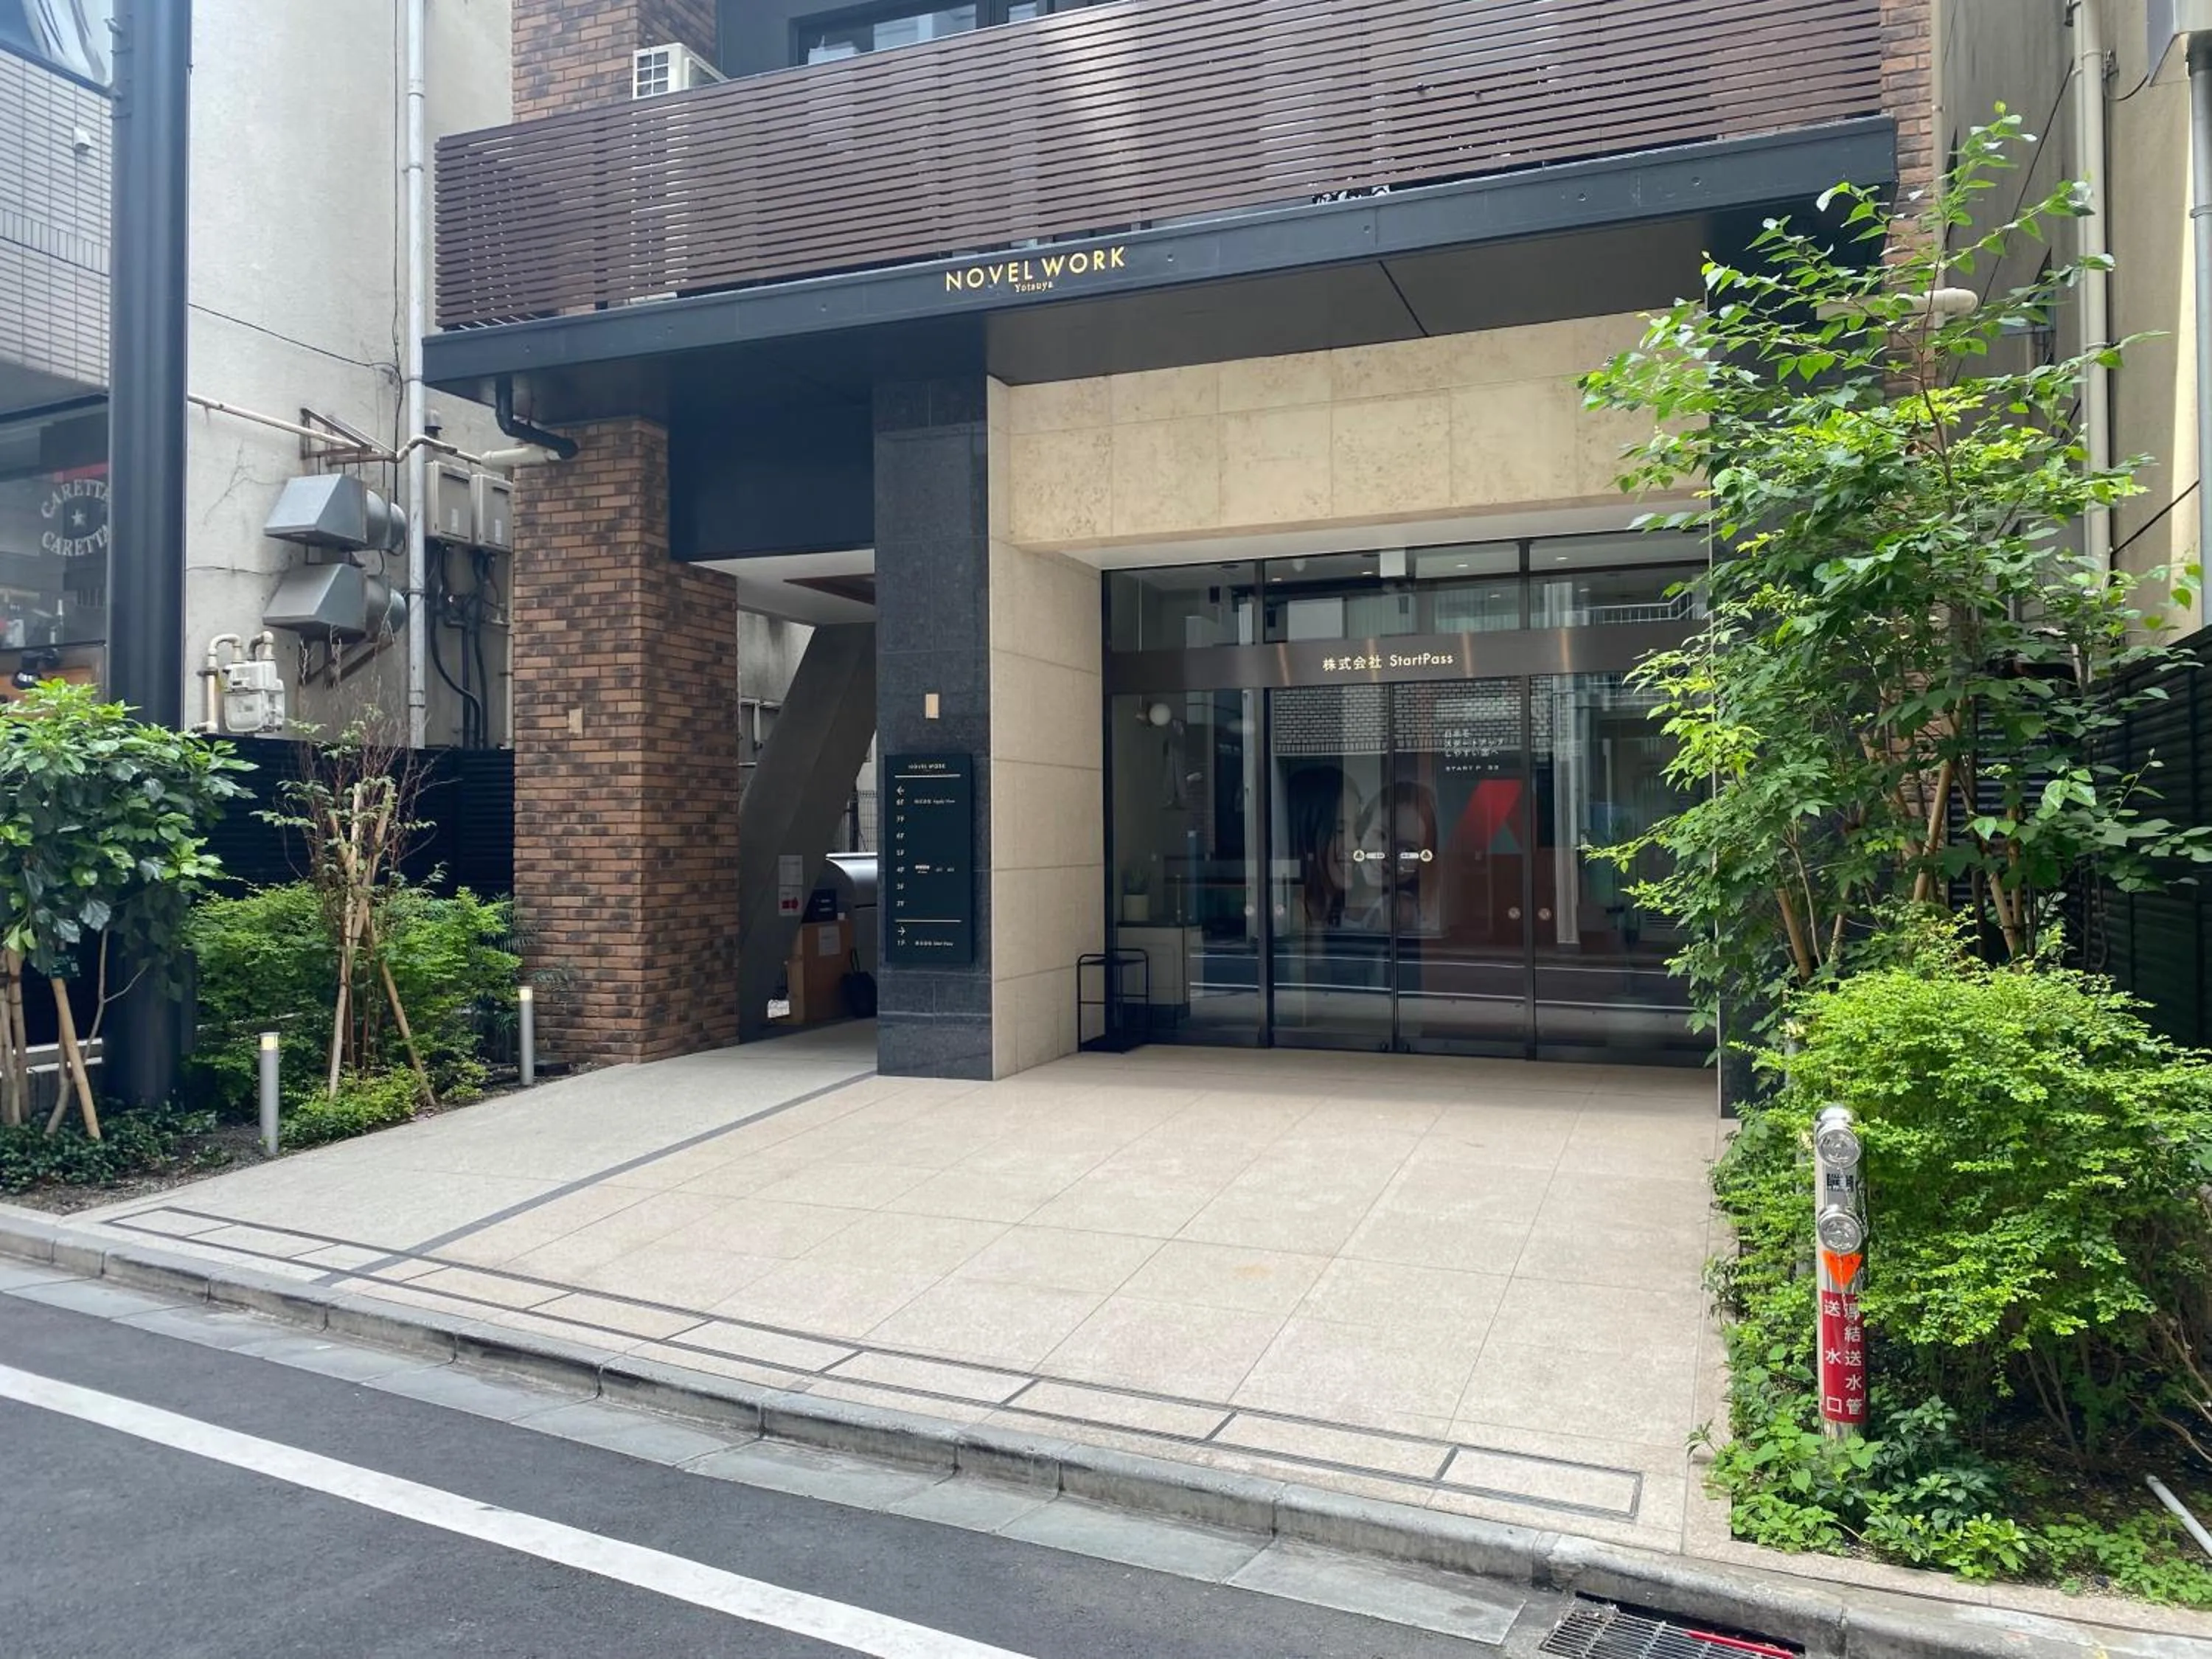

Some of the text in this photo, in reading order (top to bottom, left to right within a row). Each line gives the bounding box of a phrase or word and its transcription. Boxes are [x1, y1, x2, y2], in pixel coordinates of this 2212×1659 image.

[946, 246, 1126, 291] NOVEL WORK
[1015, 281, 1054, 293] Yotsuya
[1322, 653, 1454, 672] 株式会社 StartPass
[1823, 1298, 1843, 1414] 送水口
